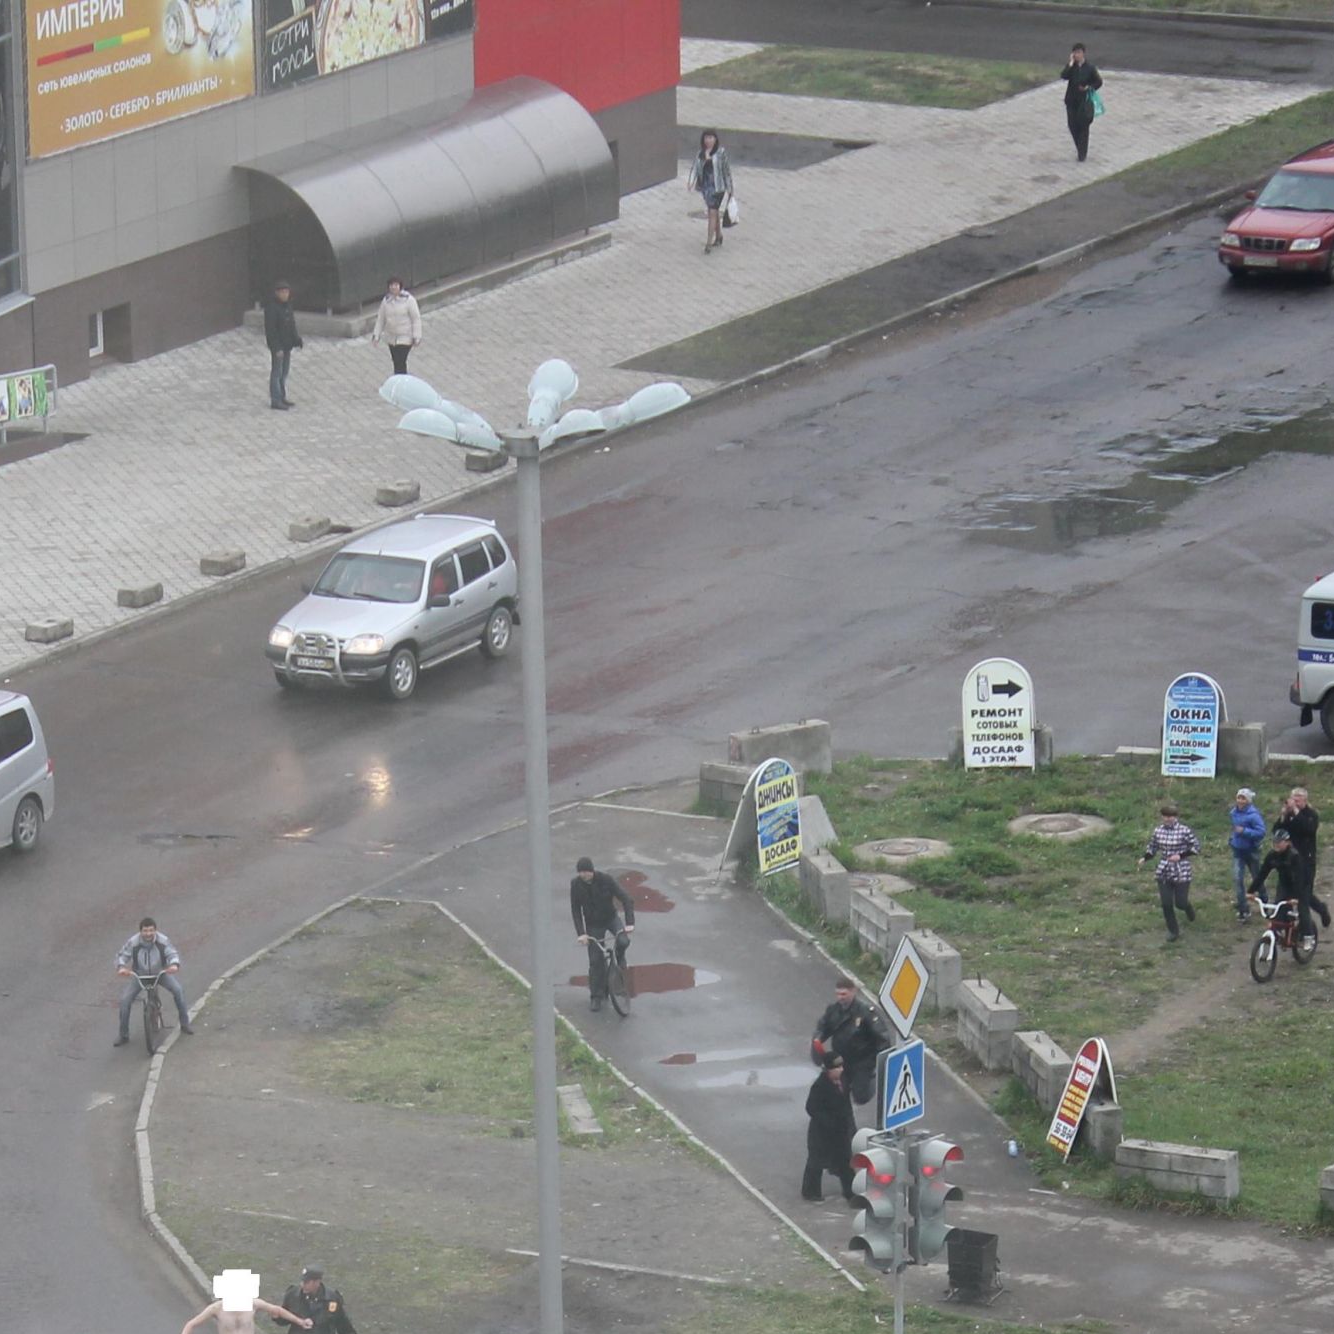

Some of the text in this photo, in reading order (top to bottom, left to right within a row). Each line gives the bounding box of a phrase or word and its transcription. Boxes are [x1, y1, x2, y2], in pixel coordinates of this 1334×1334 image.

[36, 0, 124, 40] ИМПЕРИЯ
[271, 21, 310, 56] СОТРИ
[272, 45, 315, 83] ГОЛОД
[37, 53, 152, 95] сеть ювелирных салонов
[64, 75, 218, 134] ЗОЛОТО СЕРЕБРО БРИЛЛИАНТЫ
[970, 708, 1024, 718] РЕМОНТ
[1170, 708, 1212, 720] ОКНА
[976, 720, 1018, 729] СОТОВЫХ
[1170, 724, 1212, 734] ЛОДЖИИ
[971, 732, 1024, 742] ТЕЛЕФОНОВ
[972, 744, 1025, 755] ДОСААФ
[1169, 739, 1211, 749] БАЛКОНЫ
[989, 755, 1017, 763] ЭТАЖ
[758, 778, 796, 809] ДЖИНСЫ
[764, 838, 798, 865] ДОСААФ
